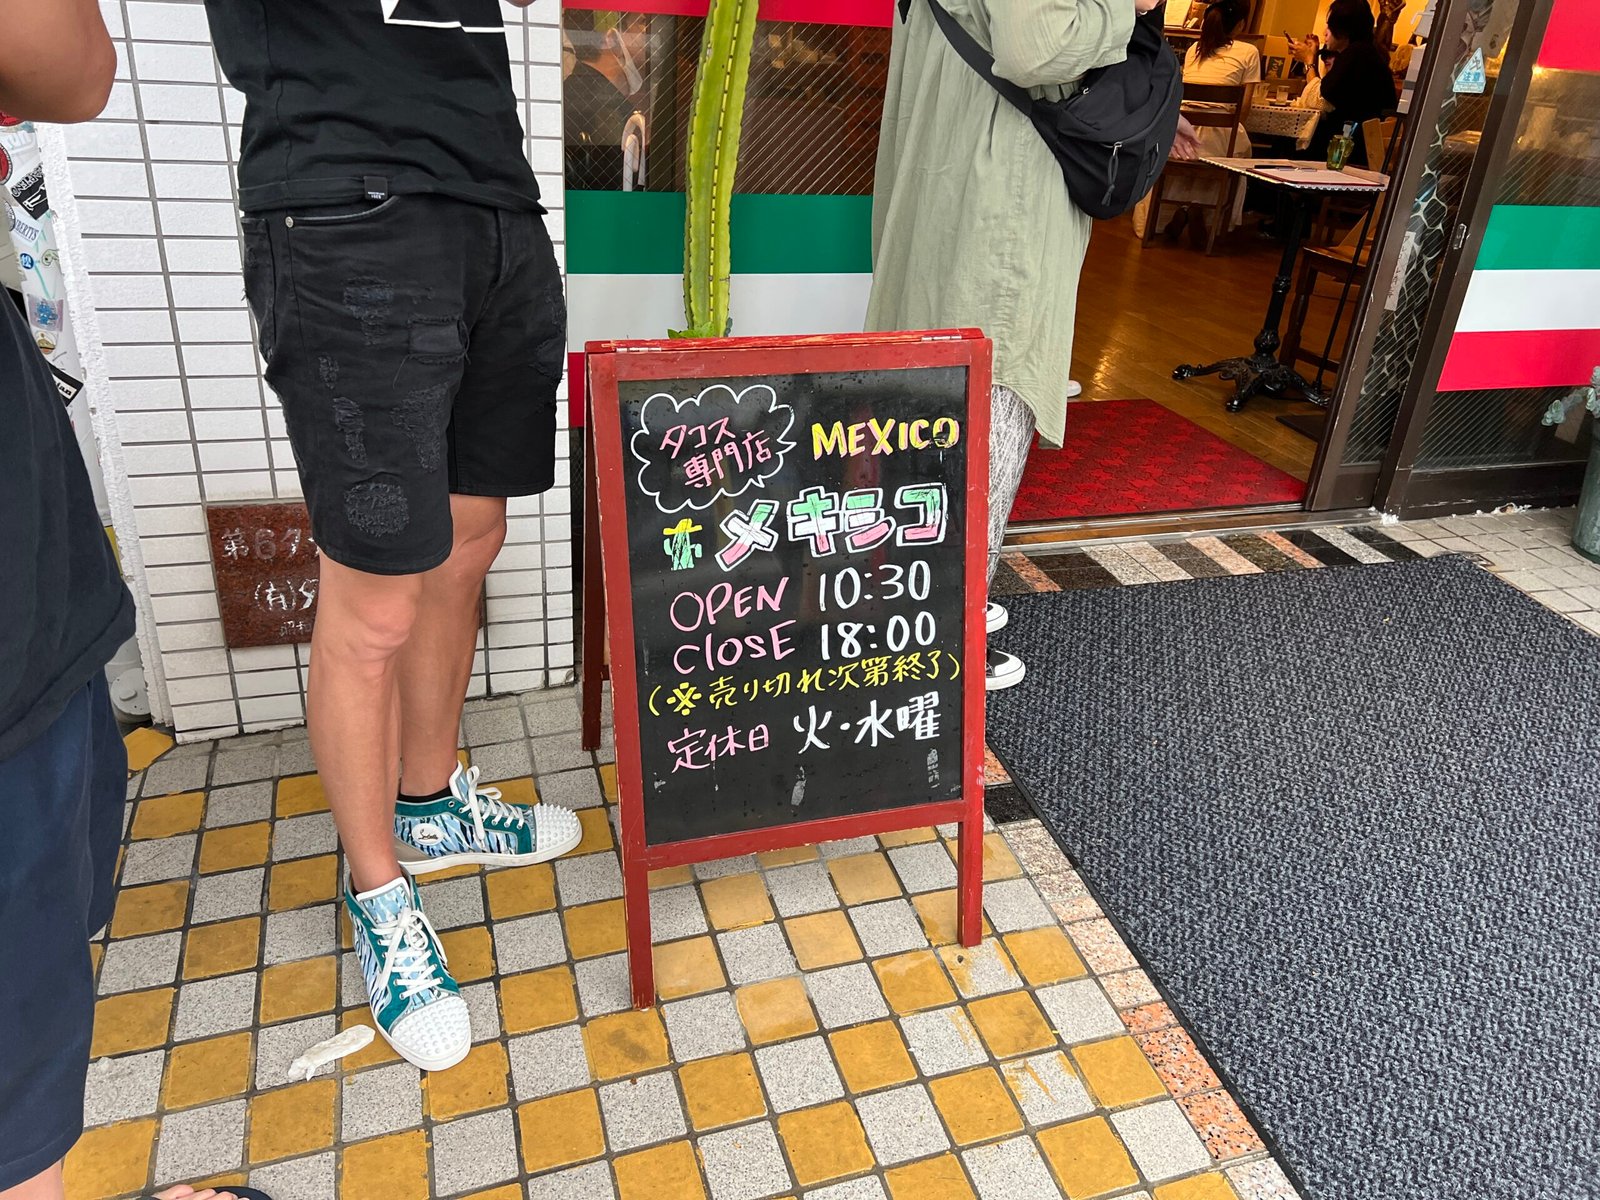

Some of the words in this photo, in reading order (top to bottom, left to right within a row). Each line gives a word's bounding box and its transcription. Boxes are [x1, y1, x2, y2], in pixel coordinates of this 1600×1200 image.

[659, 416, 736, 459] タコス
[684, 431, 772, 488] 専門店
[811, 417, 960, 461] MEXICO
[714, 482, 948, 572] メキシコ
[669, 576, 790, 632] OPEN
[818, 560, 931, 612] 10:30
[820, 611, 937, 661] 18:00
[667, 724, 770, 774] 定休日
